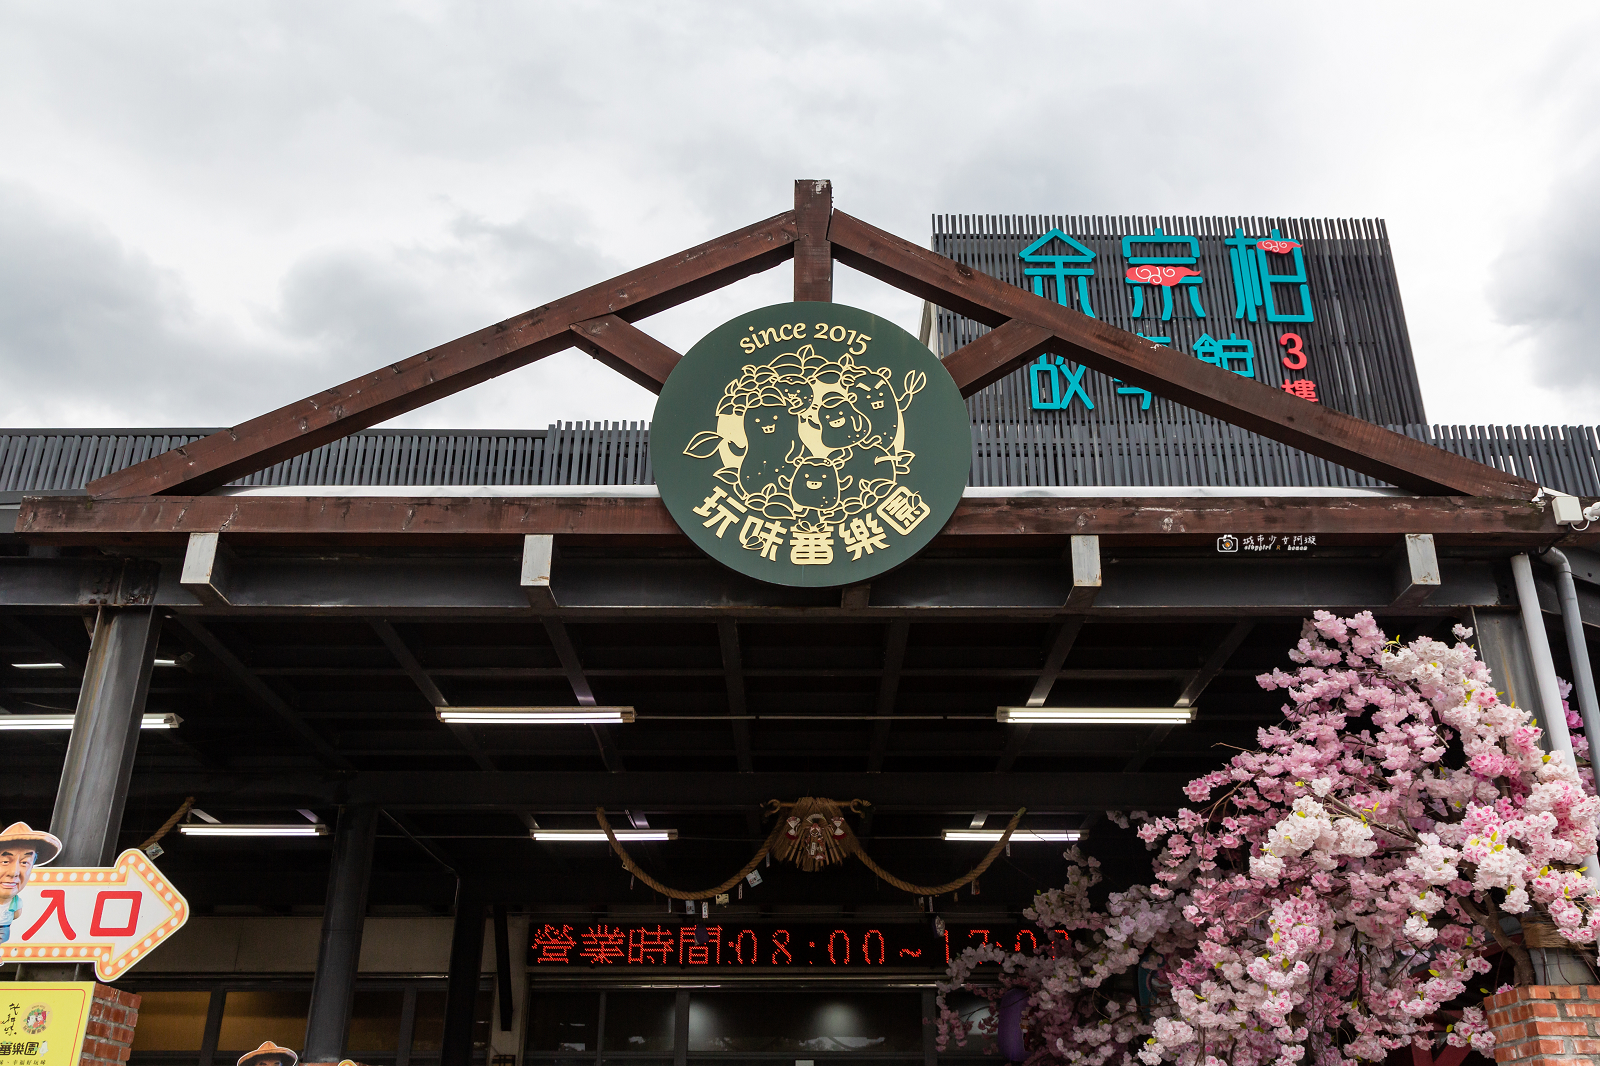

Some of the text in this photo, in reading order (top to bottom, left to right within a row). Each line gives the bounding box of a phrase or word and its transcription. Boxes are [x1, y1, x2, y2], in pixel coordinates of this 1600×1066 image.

[739, 322, 872, 356] since 2015
[21, 889, 143, 941] 入口
